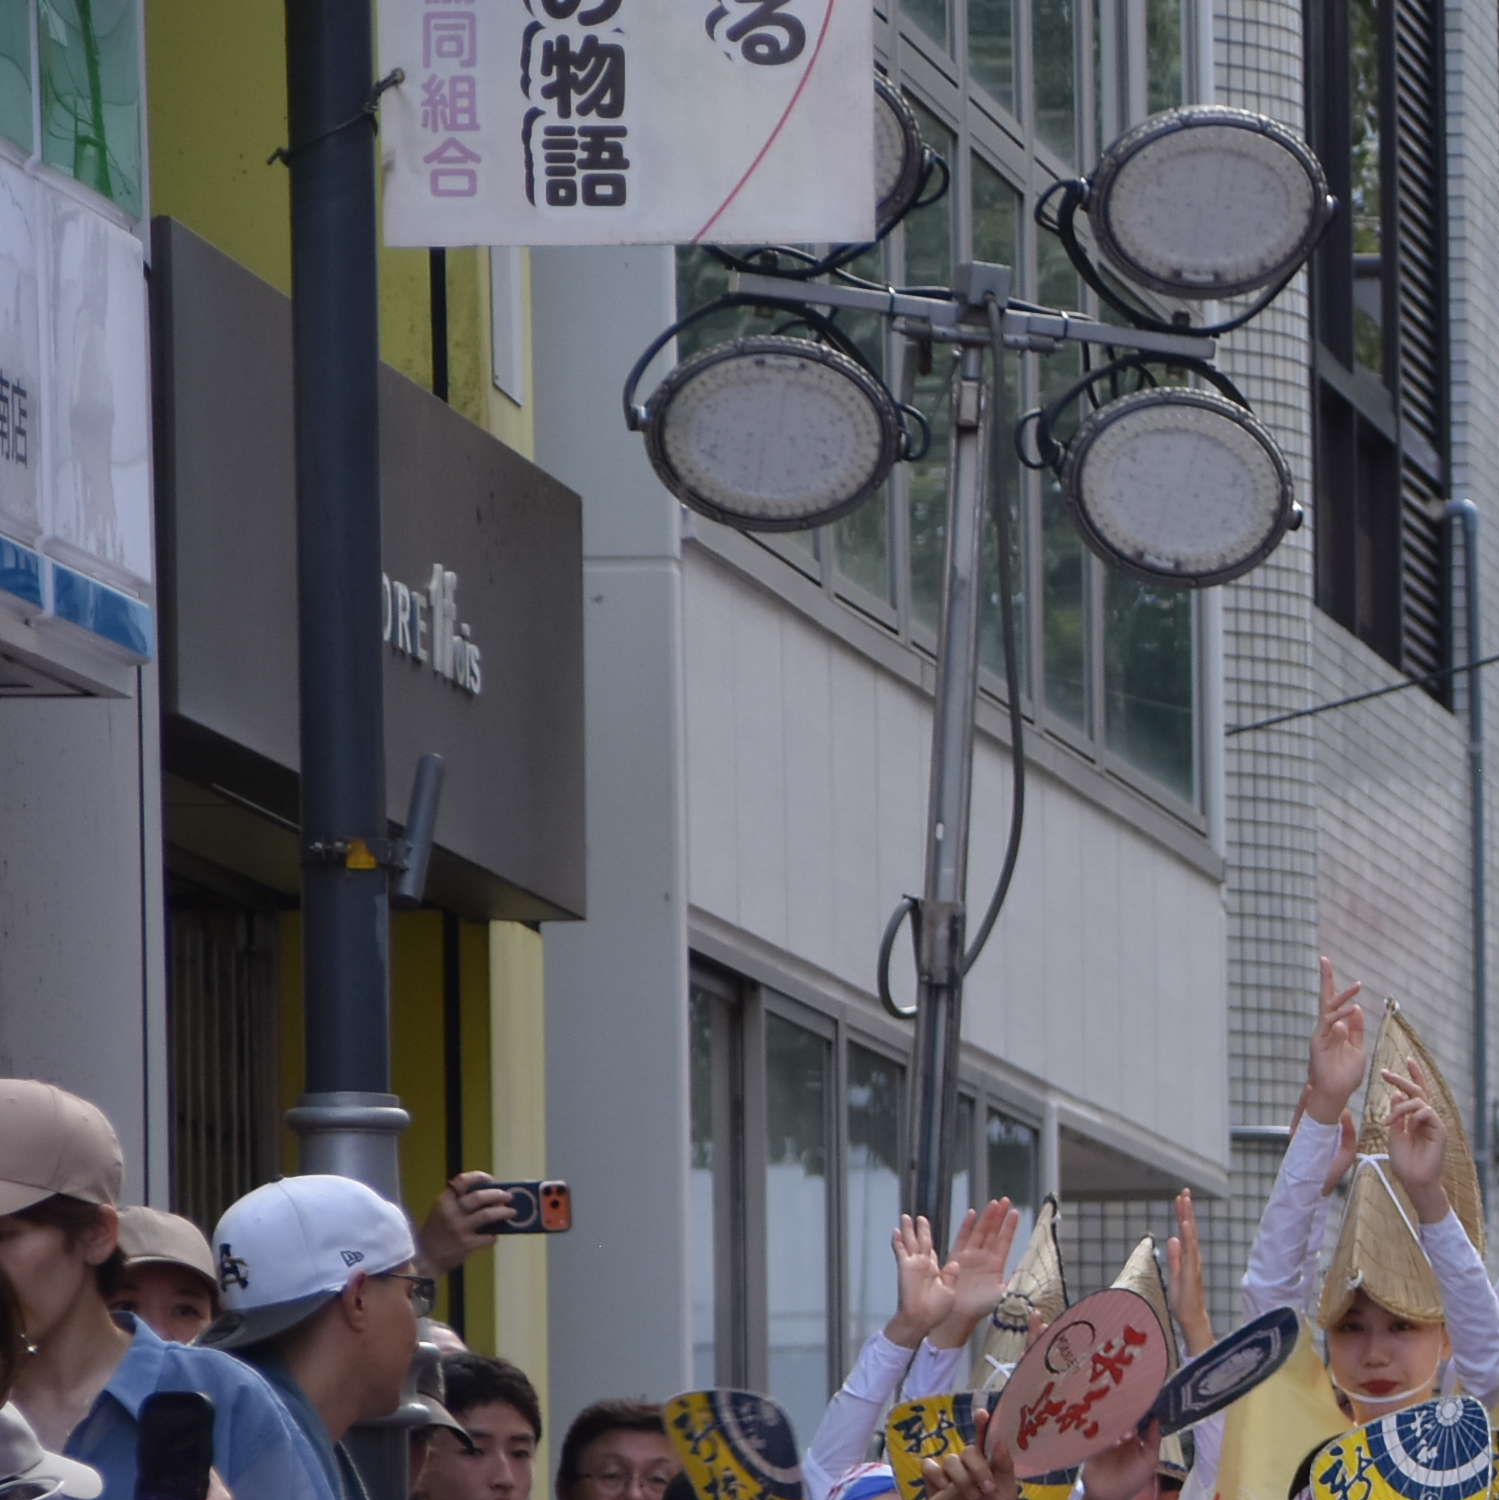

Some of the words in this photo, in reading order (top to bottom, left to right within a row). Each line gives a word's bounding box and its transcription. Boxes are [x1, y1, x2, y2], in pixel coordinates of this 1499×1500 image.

[421, 0, 482, 197] 同組合
[1410, 1410, 1439, 1464] 大和
